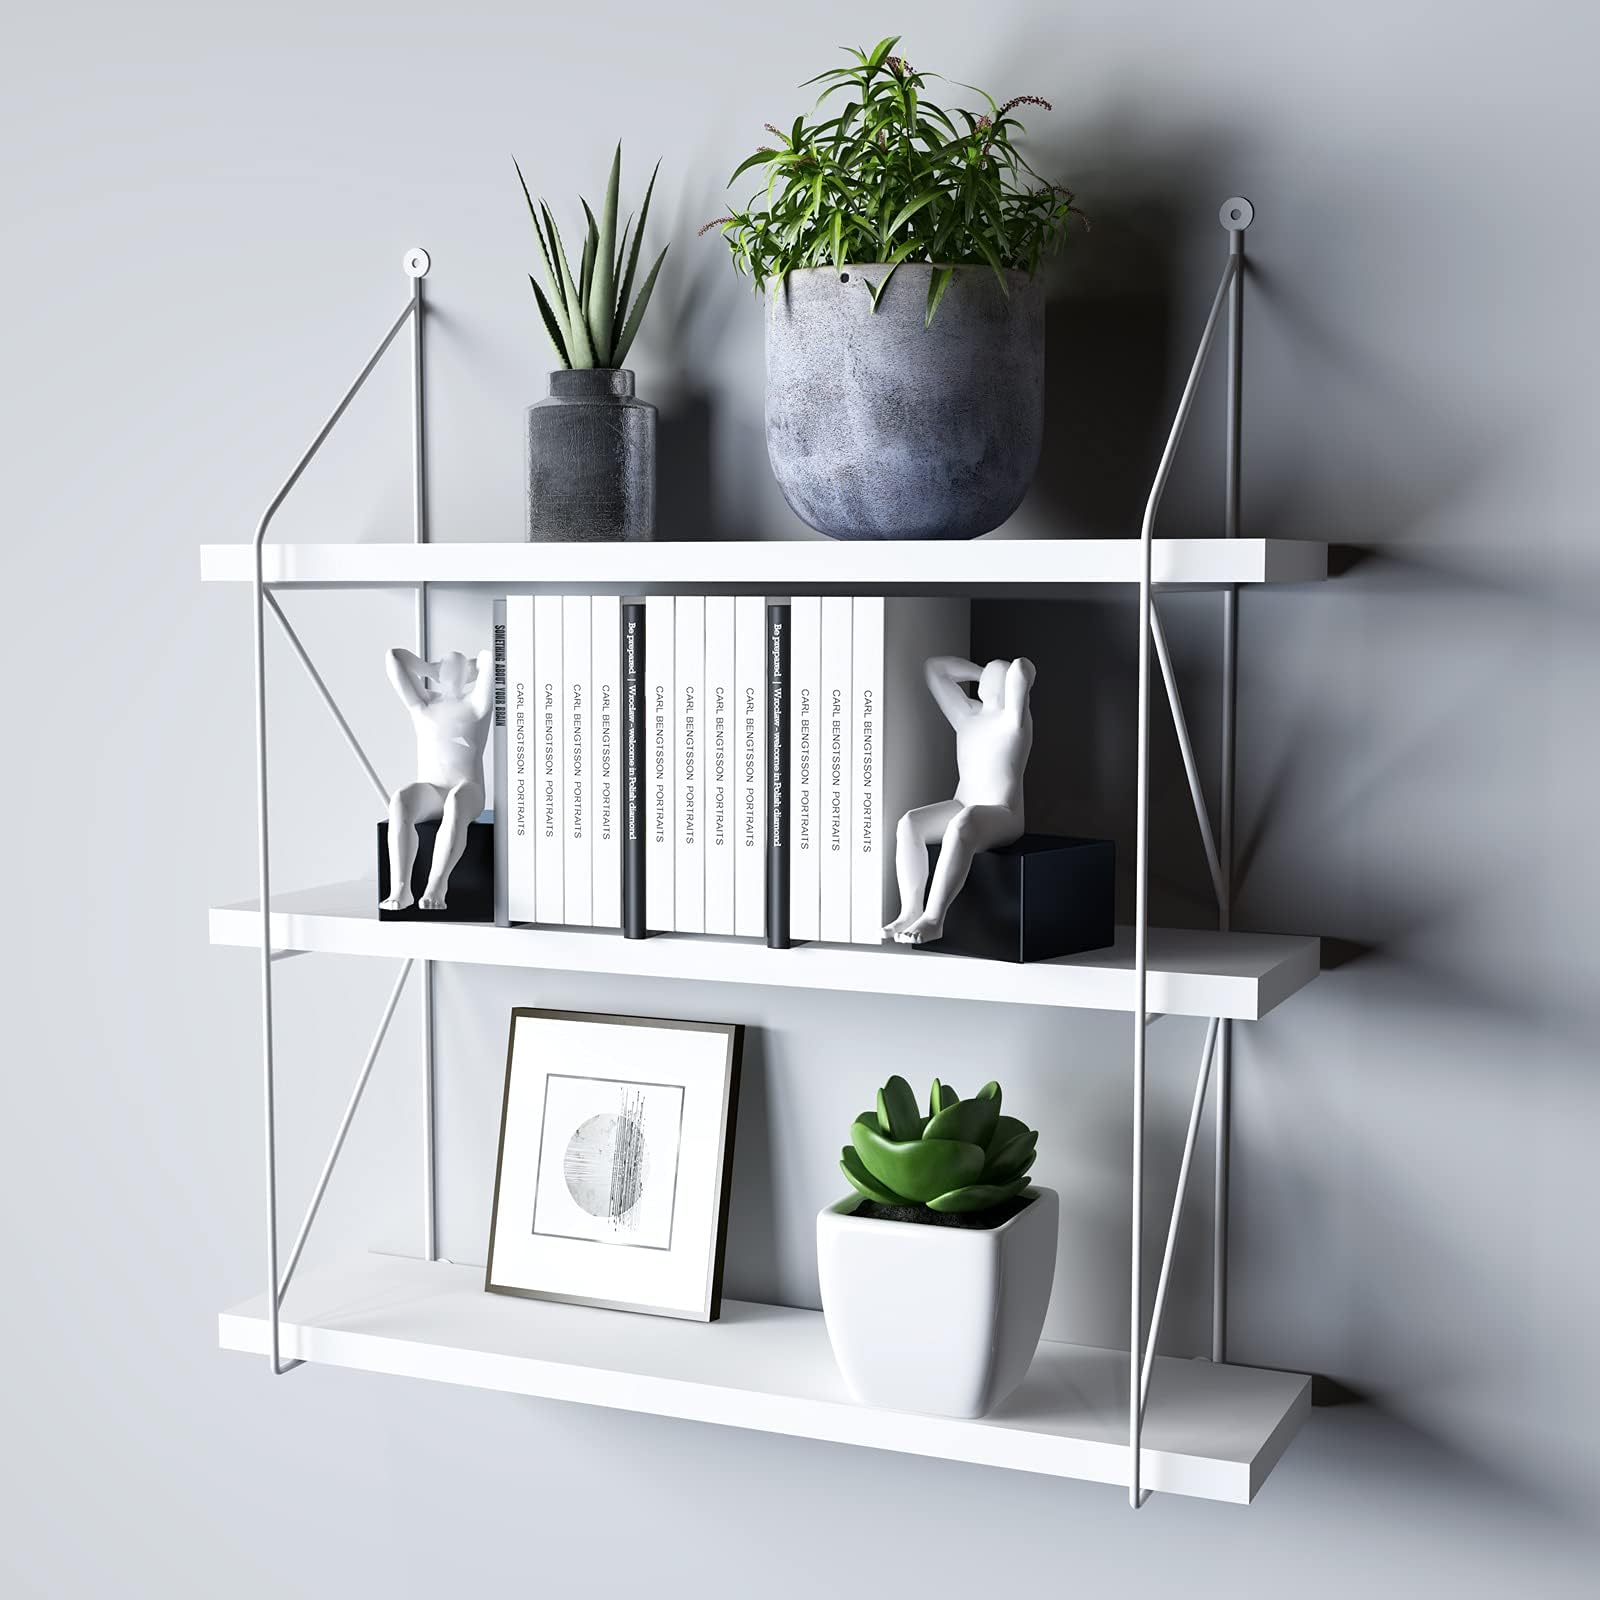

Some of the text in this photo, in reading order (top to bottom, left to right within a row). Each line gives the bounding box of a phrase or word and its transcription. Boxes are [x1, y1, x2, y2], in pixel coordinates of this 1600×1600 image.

[626, 635, 637, 674] prepared
[628, 622, 637, 634] Be
[771, 636, 782, 677] prepared
[773, 623, 782, 636] Be
[494, 624, 506, 727] SOMETHING ABOUT YOUR BRAIN
[516, 682, 525, 835] CARL BENGTSSON PORTRAITS
[544, 683, 554, 837] CARL BENGTSSON PORTRAITS
[573, 683, 582, 838] CARL BENGTSSON PORTRAITS
[601, 684, 611, 839] CARL BENGTSSON PORTRAITS
[628, 728, 637, 766] welcome
[628, 767, 637, 776] in
[655, 685, 665, 842] CARL BENGTSSON PORTRAITS
[685, 686, 695, 844] CARL BENGTSSON PORTRAITS
[715, 686, 725, 845] CARL BENGTSSON PORTRAITS
[745, 687, 755, 846] CARL BENGTSSON PORTRAITS
[773, 732, 782, 771] welcome
[773, 772, 782, 781] in
[800, 688, 810, 849] CARL BENGTSSON PORTRAITS
[831, 689, 841, 851] CARL BENGTSSON PORTRAITS
[862, 689, 873, 852] CARL BENGTSSON PORTRAITS
[628, 777, 637, 801] Polish
[628, 802, 637, 840] diamond
[773, 782, 782, 807] Polish
[773, 808, 782, 847] diamond
